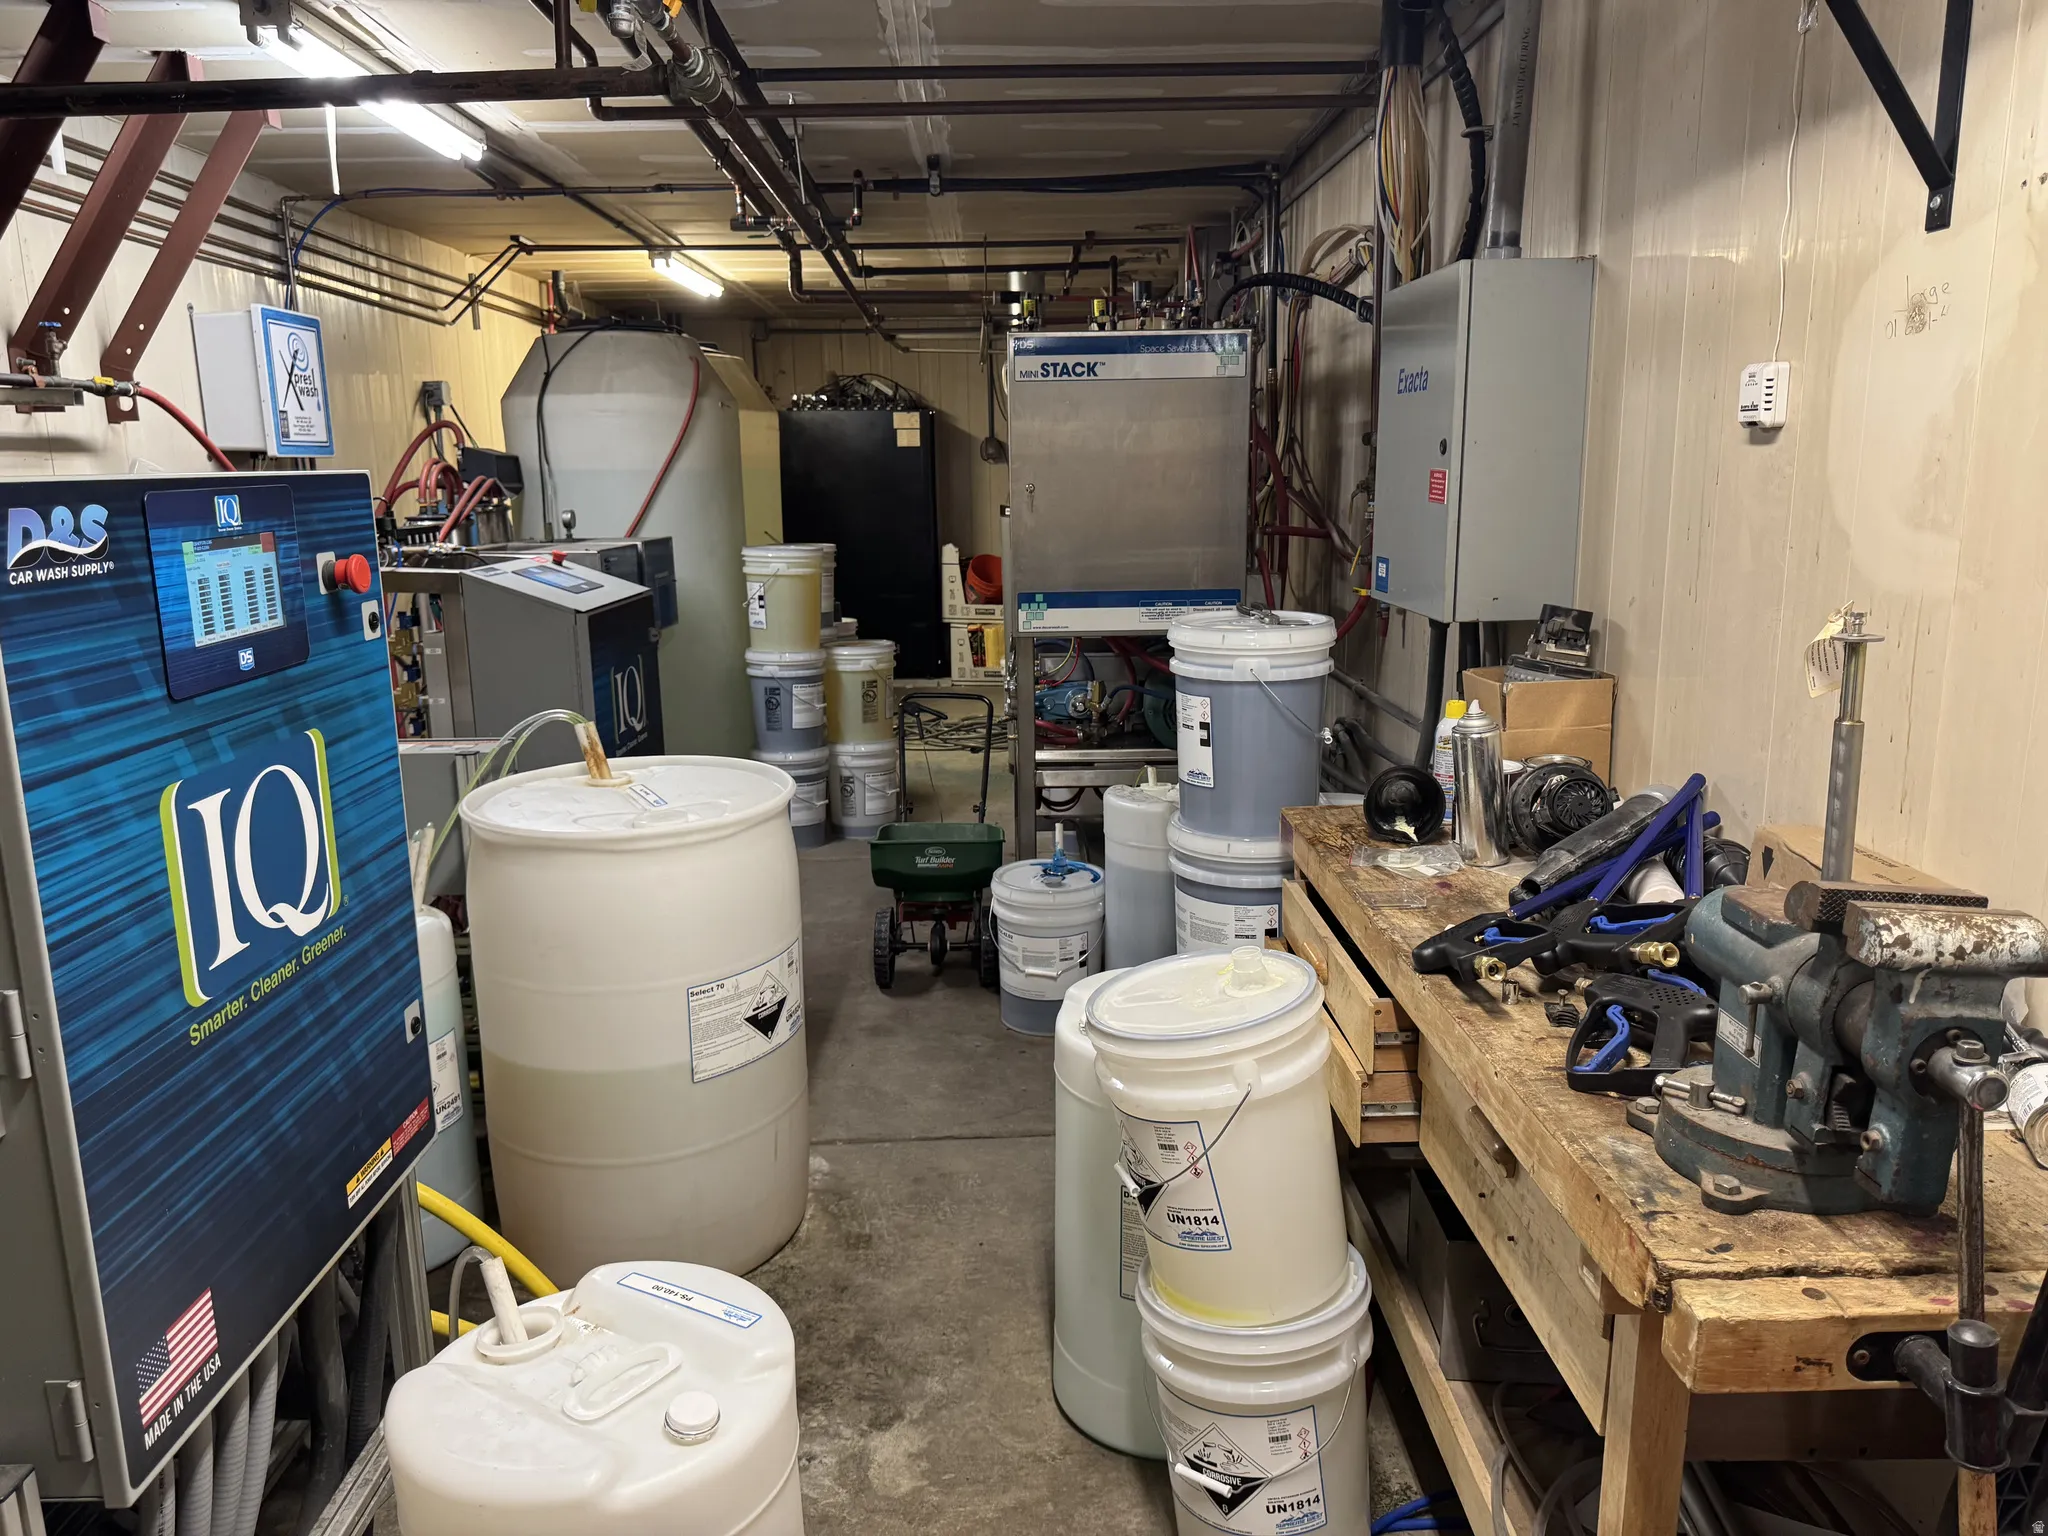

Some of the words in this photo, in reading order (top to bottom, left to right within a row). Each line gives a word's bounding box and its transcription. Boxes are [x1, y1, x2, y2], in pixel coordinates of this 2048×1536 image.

[1140, 344, 1165, 353] Space
[1020, 370, 1038, 378] MINI
[1397, 366, 1429, 394] Exacta
[7, 504, 109, 569] D&S
[9, 570, 34, 585] CAR
[36, 566, 69, 581] WASH
[614, 665, 644, 734] IQ
[187, 764, 329, 971] IQ
[915, 856, 929, 864] Turf
[930, 856, 956, 864] Builder
[189, 997, 248, 1046] Smarter.
[250, 960, 300, 1003] Cleaner.
[302, 923, 347, 966] Greener.
[690, 987, 714, 997] Select
[716, 982, 725, 990] 70
[1166, 1212, 1220, 1226] UN1814
[651, 1284, 694, 1302] PS-140.00
[144, 1407, 173, 1451] MADE
[173, 1395, 184, 1416] IN
[185, 1372, 203, 1403] THE
[203, 1352, 222, 1381] USA
[1202, 1467, 1242, 1486] CORROSIVE
[1266, 1494, 1321, 1514] UN1814
